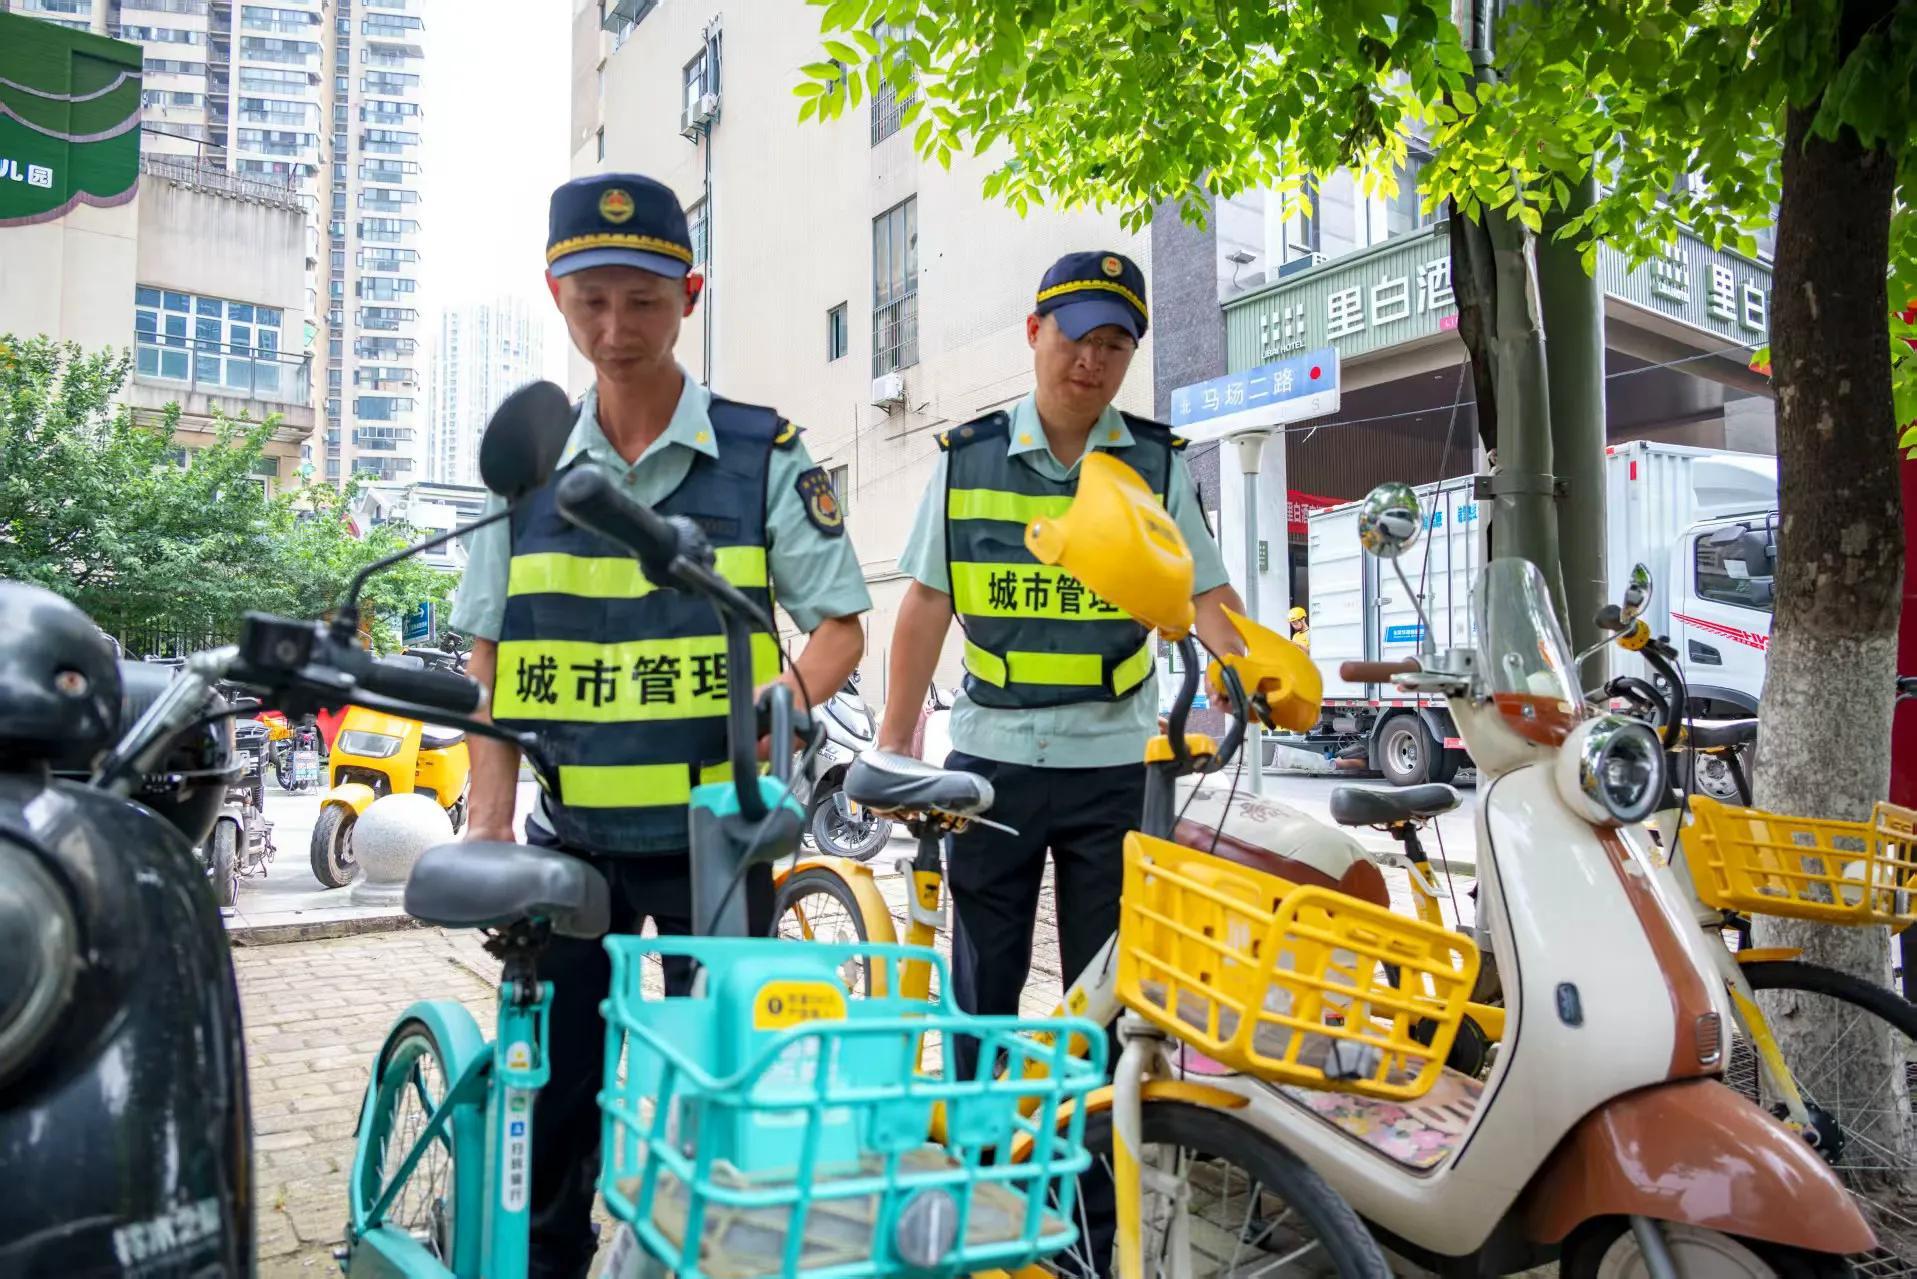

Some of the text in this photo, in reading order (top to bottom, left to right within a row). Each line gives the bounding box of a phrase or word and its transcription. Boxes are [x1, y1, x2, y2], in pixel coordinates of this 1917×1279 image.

[1280, 340, 1306, 353] HOTEL
[1202, 367, 1296, 411] 马场二路
[516, 654, 728, 708] 城市管理
